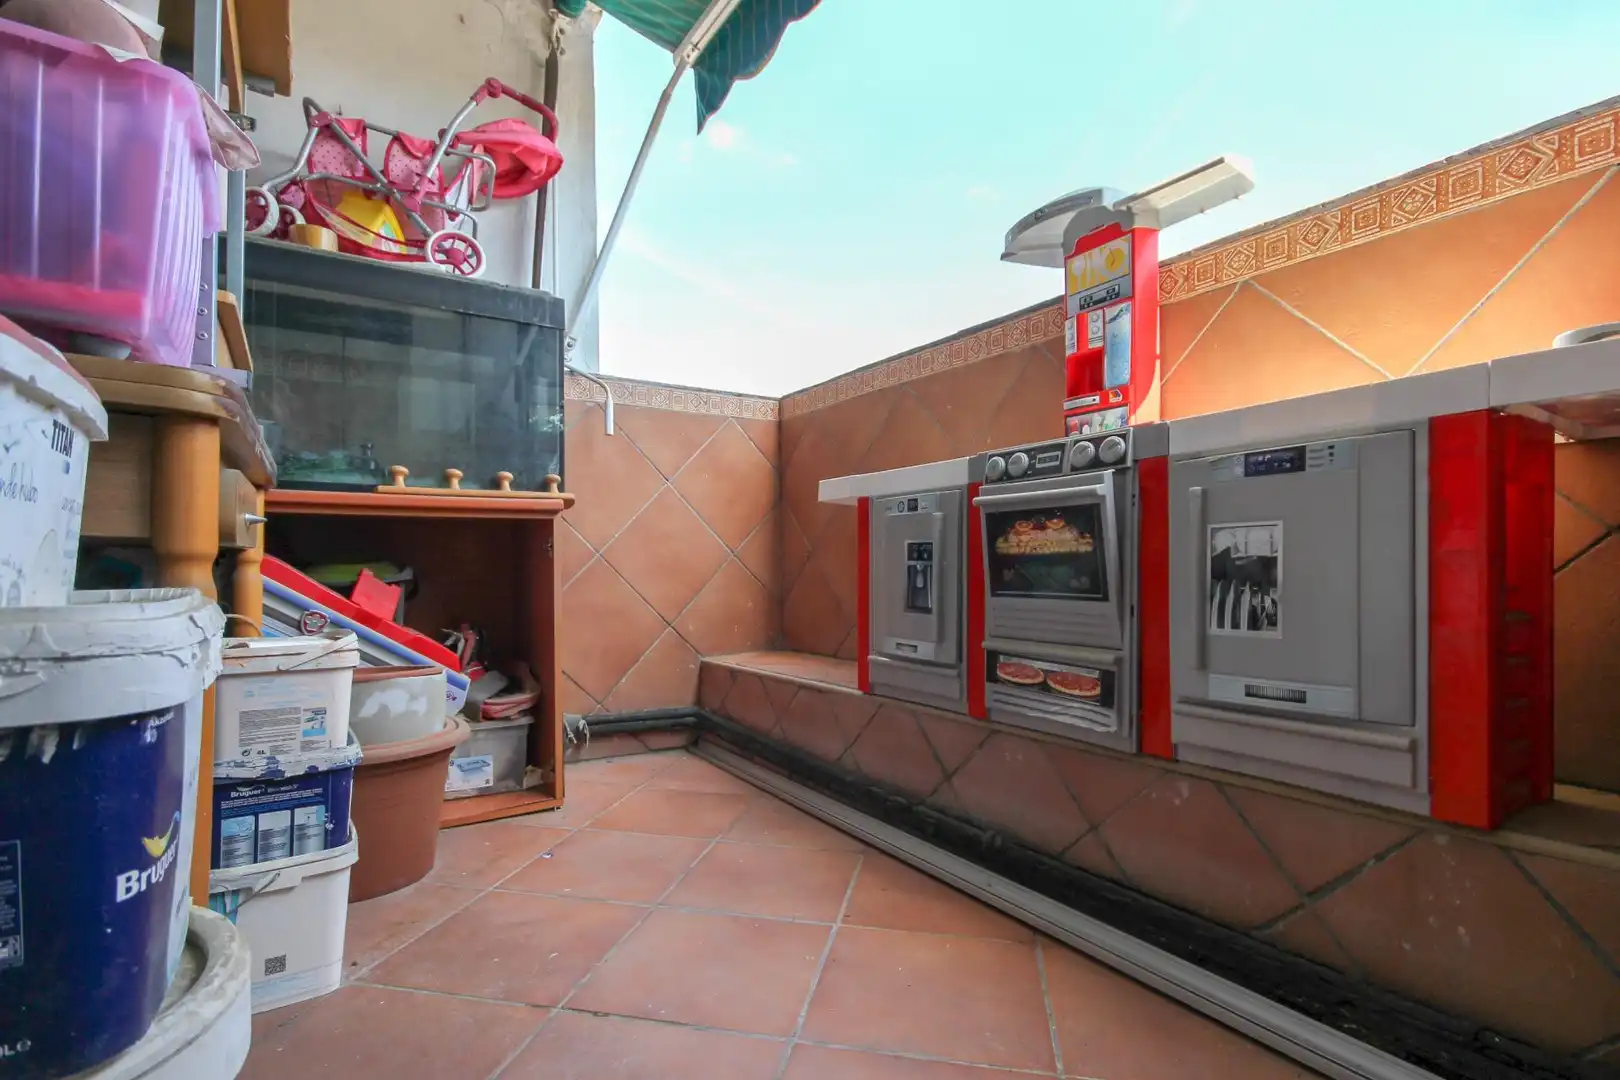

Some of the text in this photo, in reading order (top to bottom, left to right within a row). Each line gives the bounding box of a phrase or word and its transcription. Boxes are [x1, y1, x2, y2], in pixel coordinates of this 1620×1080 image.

[51, 418, 74, 458] TITAN
[230, 788, 262, 799] Bruguer
[116, 838, 178, 903] Bruguer
